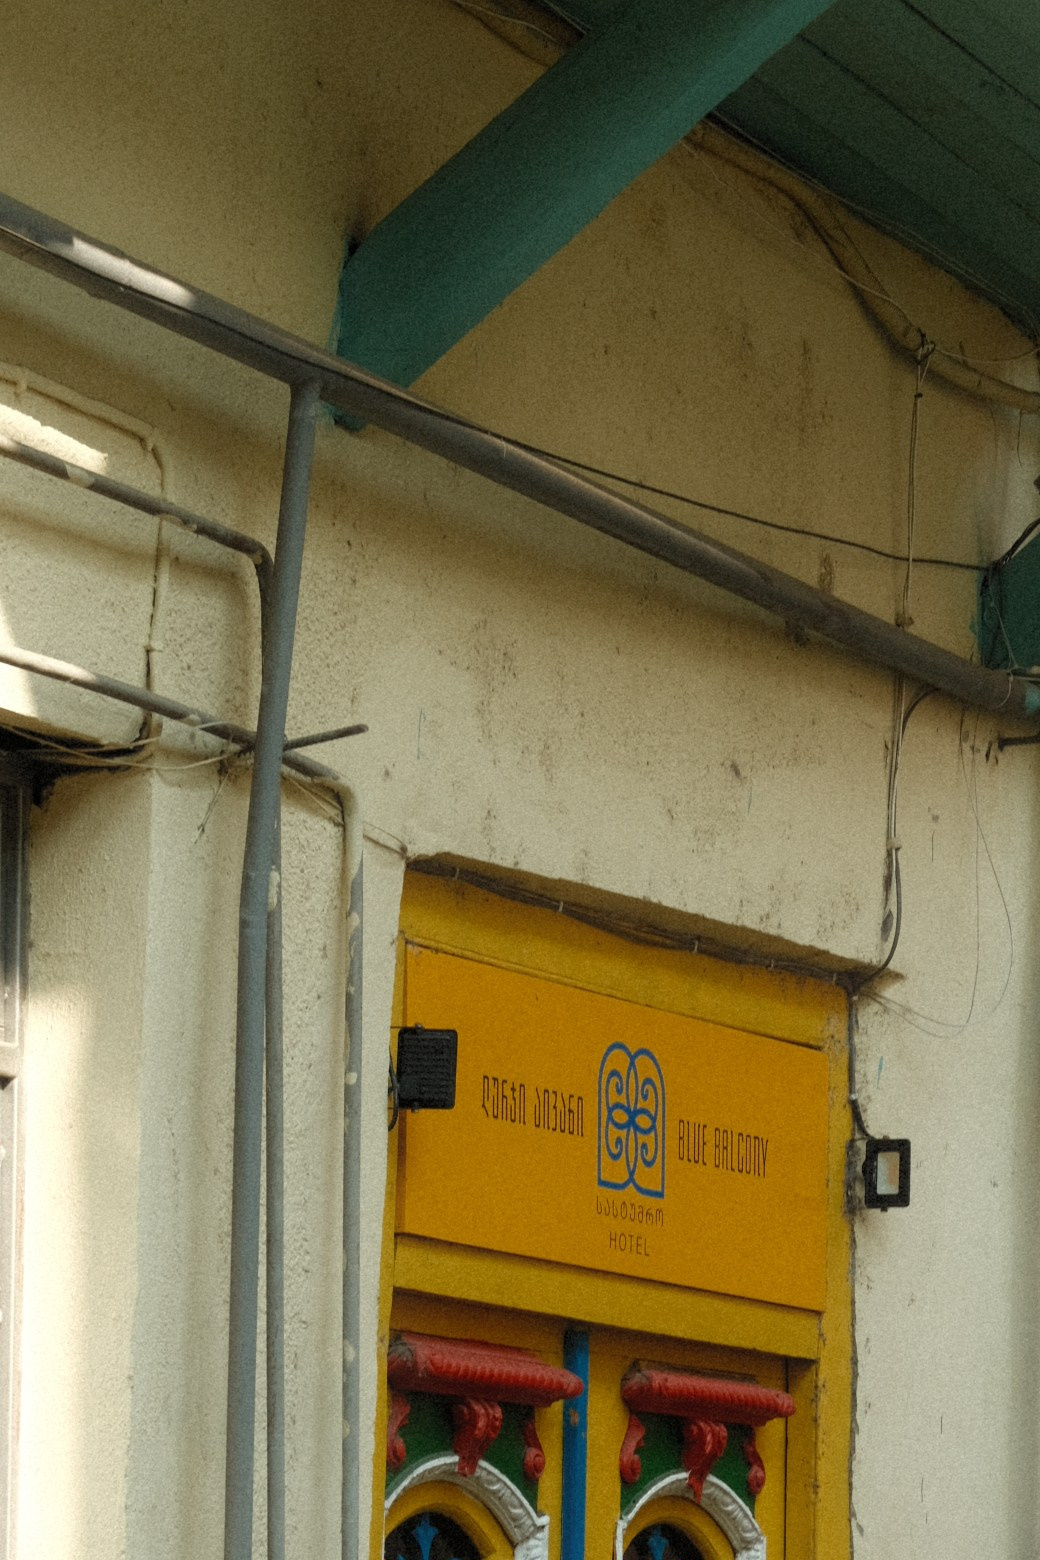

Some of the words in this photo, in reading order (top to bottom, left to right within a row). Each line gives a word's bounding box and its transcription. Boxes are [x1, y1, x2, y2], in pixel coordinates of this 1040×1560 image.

[535, 1086, 584, 1137] აივანი
[678, 1119, 707, 1167] BLUE
[714, 1127, 769, 1178] BALCONY
[596, 1195, 664, 1227] სასტუმრო
[609, 1231, 650, 1257] HOTEL
